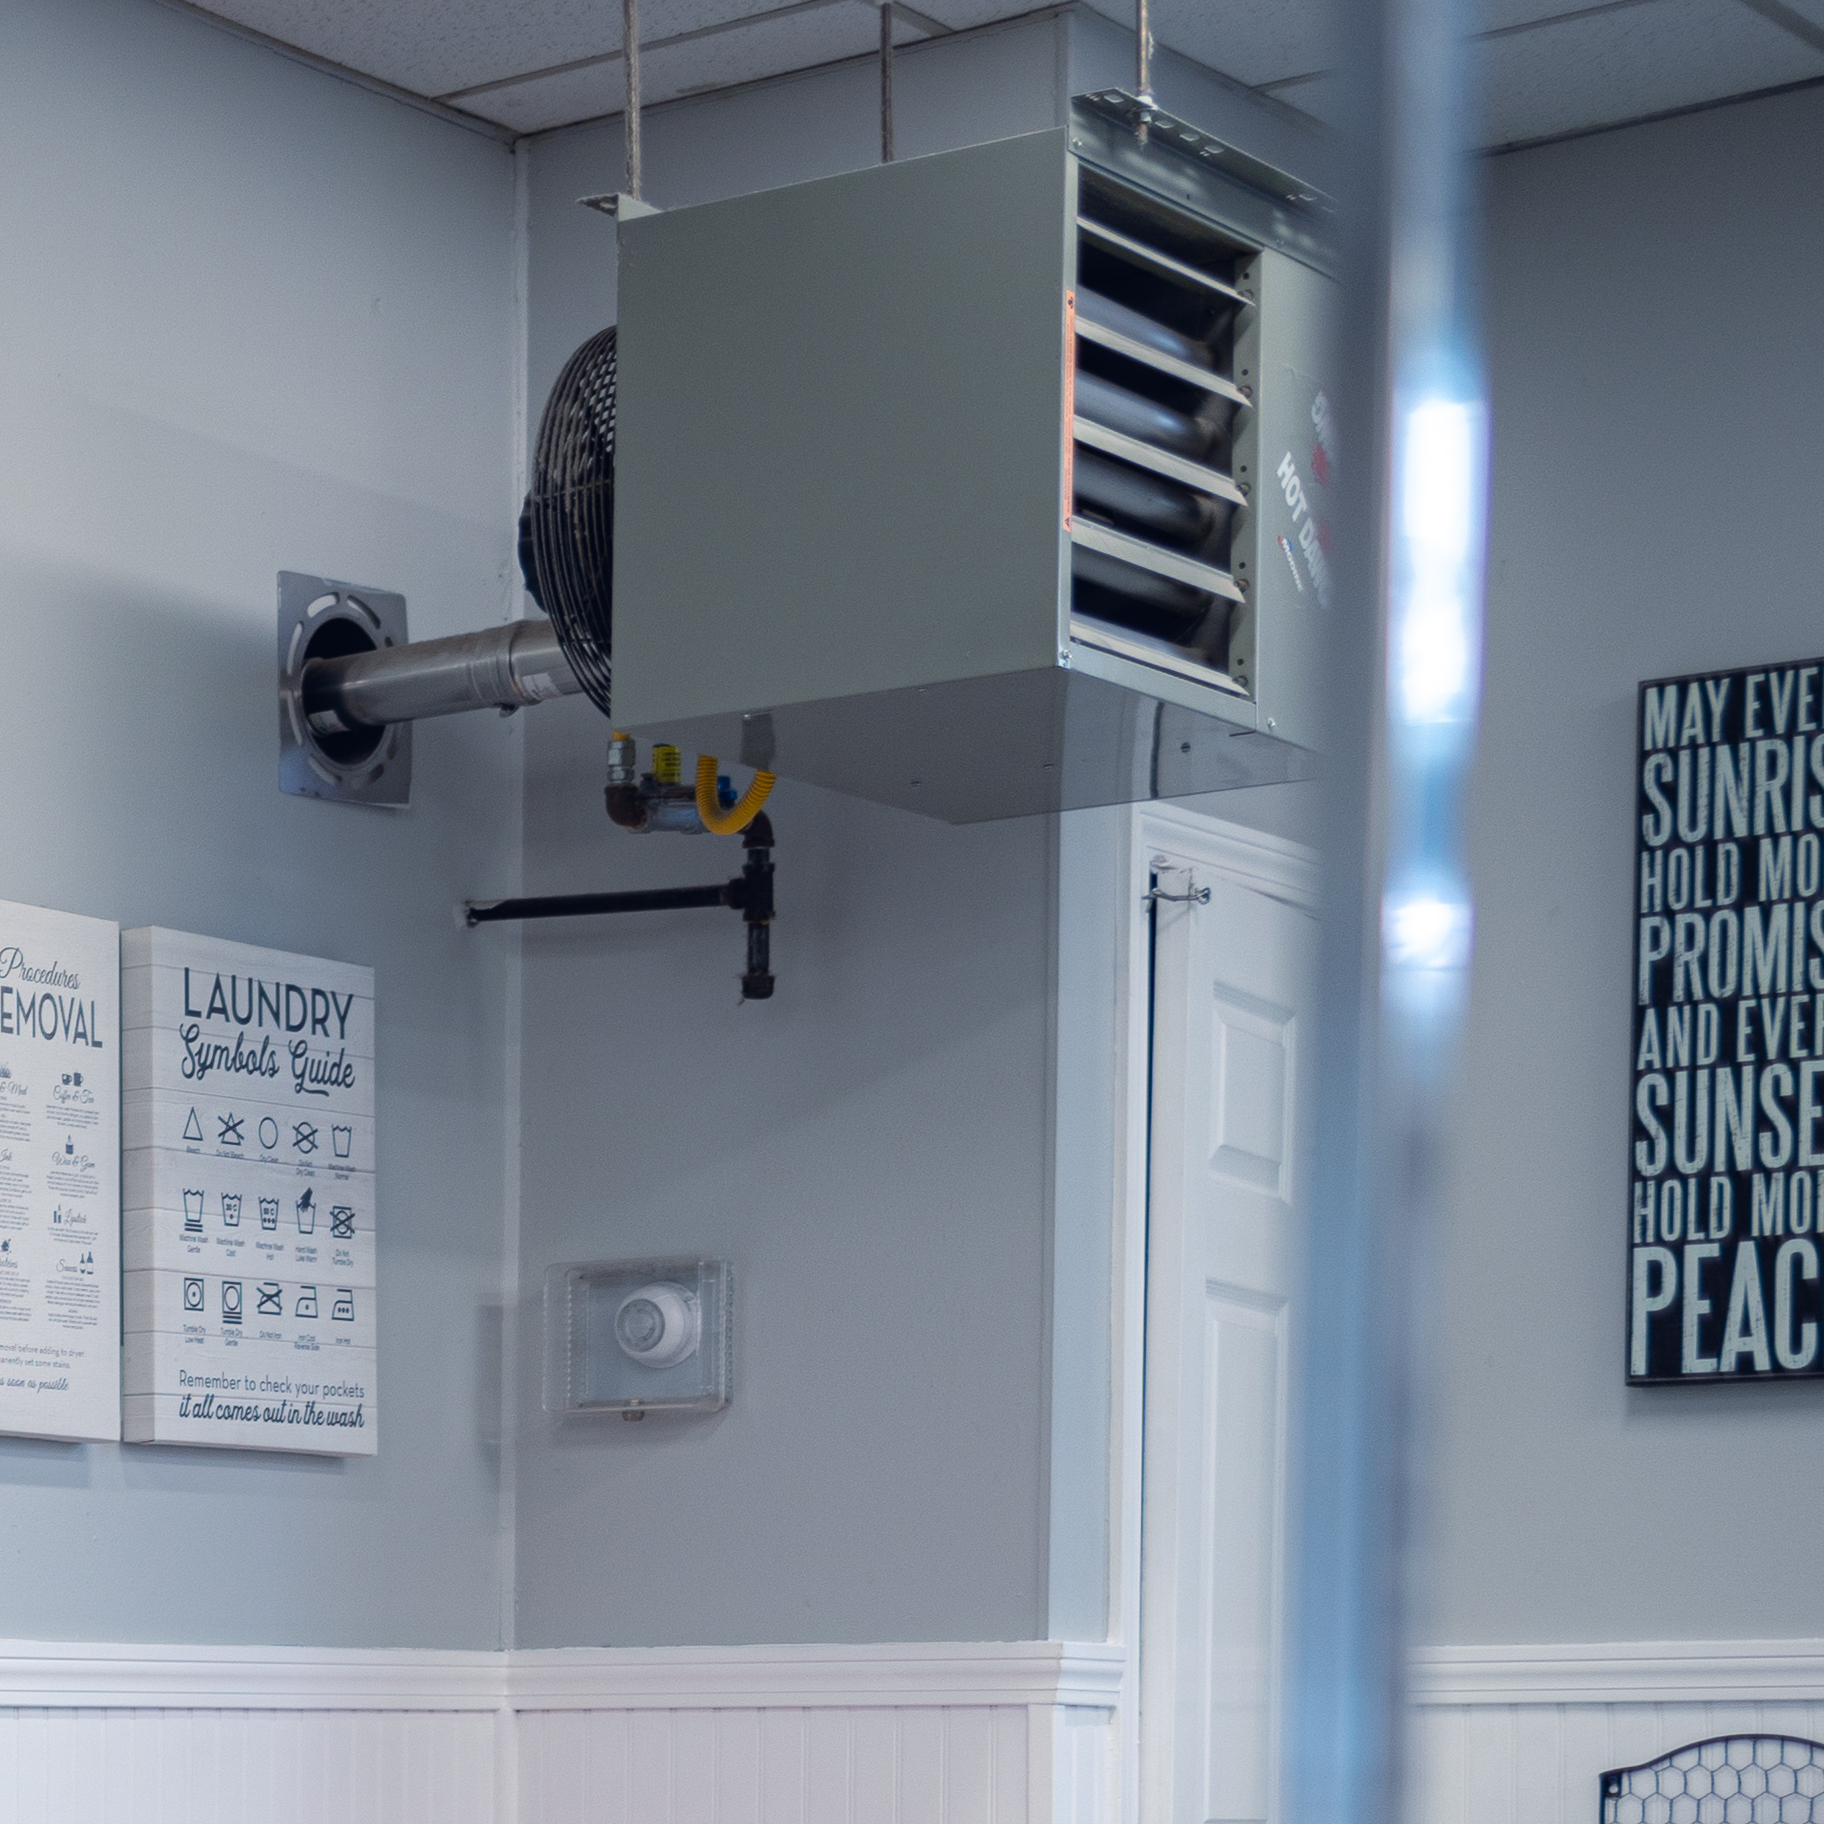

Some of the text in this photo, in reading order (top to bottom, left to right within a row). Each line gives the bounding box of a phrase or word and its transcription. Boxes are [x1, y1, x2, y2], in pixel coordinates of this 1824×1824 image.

[1644, 665, 1824, 750] MAY EVE
[1640, 833, 1820, 913] HOLD MO
[184, 967, 354, 1040] LAUNDRY
[1637, 1003, 1718, 1071] AND
[179, 1023, 356, 1097] Symbols Guide
[1635, 1061, 1824, 1176] SUNSE
[1633, 1169, 1824, 1244] HOLD MO
[1630, 1239, 1824, 1376] PEAC
[179, 1370, 364, 1399] Remember to check your pockets
[179, 1394, 365, 1428] it all comes out in the wash
